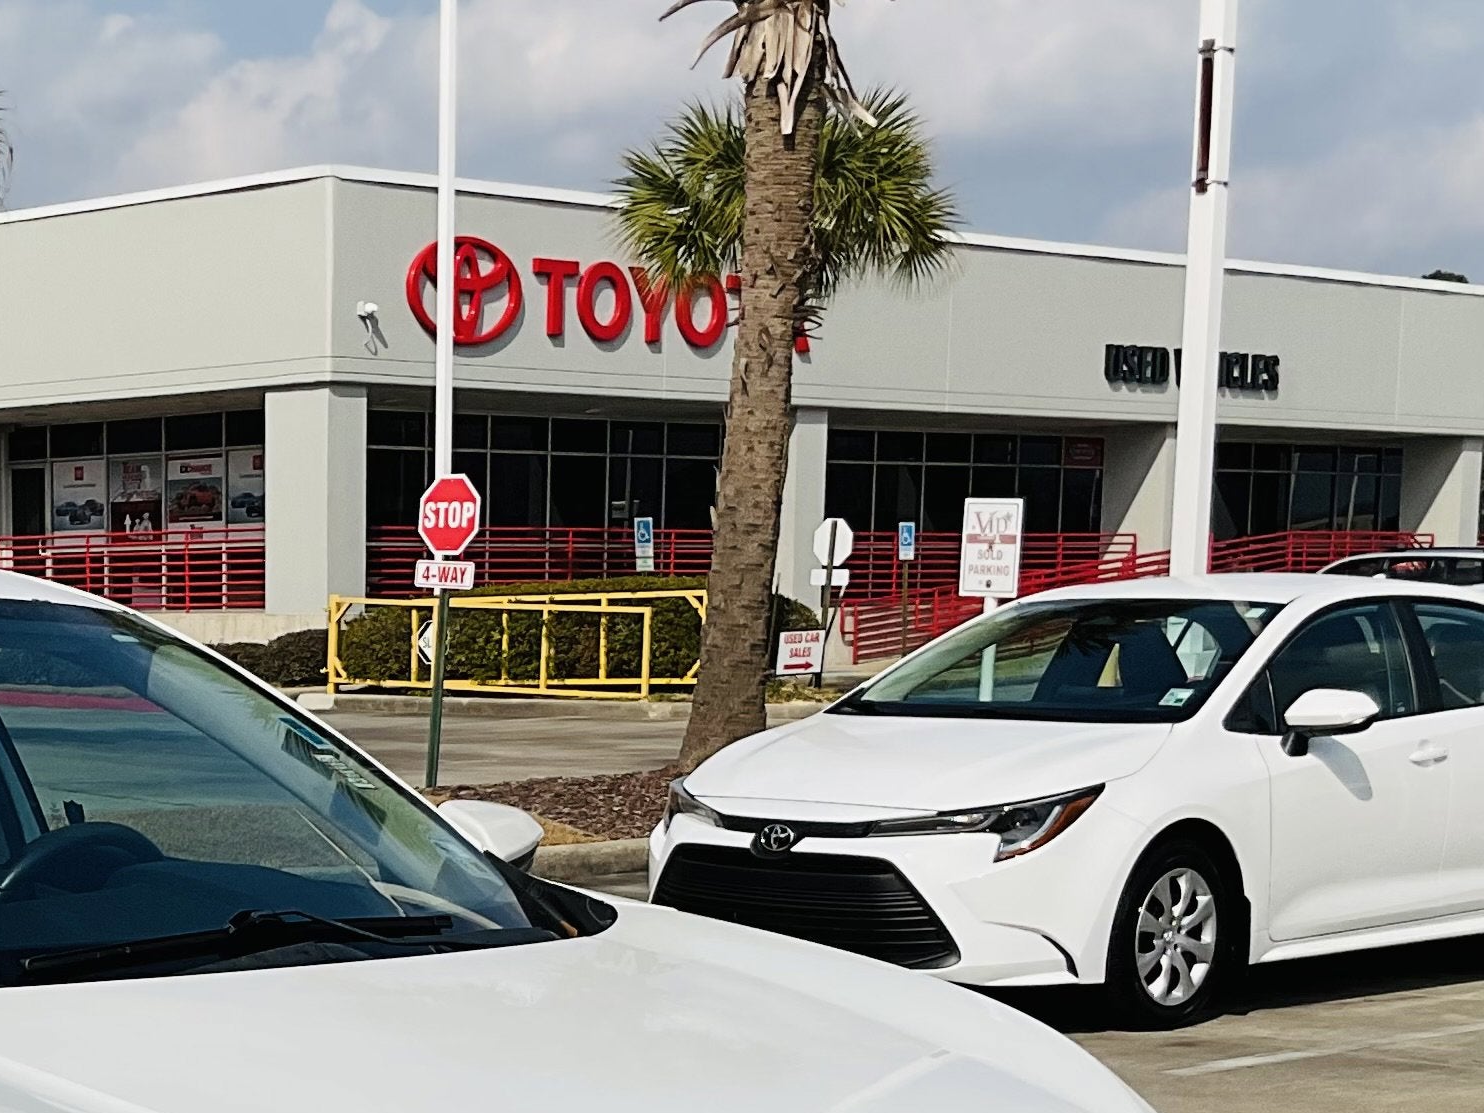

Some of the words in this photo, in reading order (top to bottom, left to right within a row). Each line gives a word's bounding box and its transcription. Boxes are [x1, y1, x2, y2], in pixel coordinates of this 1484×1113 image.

[533, 258, 811, 354] TOYO
[1104, 344, 1170, 383] USED
[423, 501, 475, 529] STOP
[977, 549, 1003, 561] SOLD
[422, 566, 468, 584] 4-WAY
[968, 564, 1010, 576] PARKING
[784, 633, 803, 644] USED
[805, 632, 820, 643] CAR
[789, 646, 812, 658] SALES
